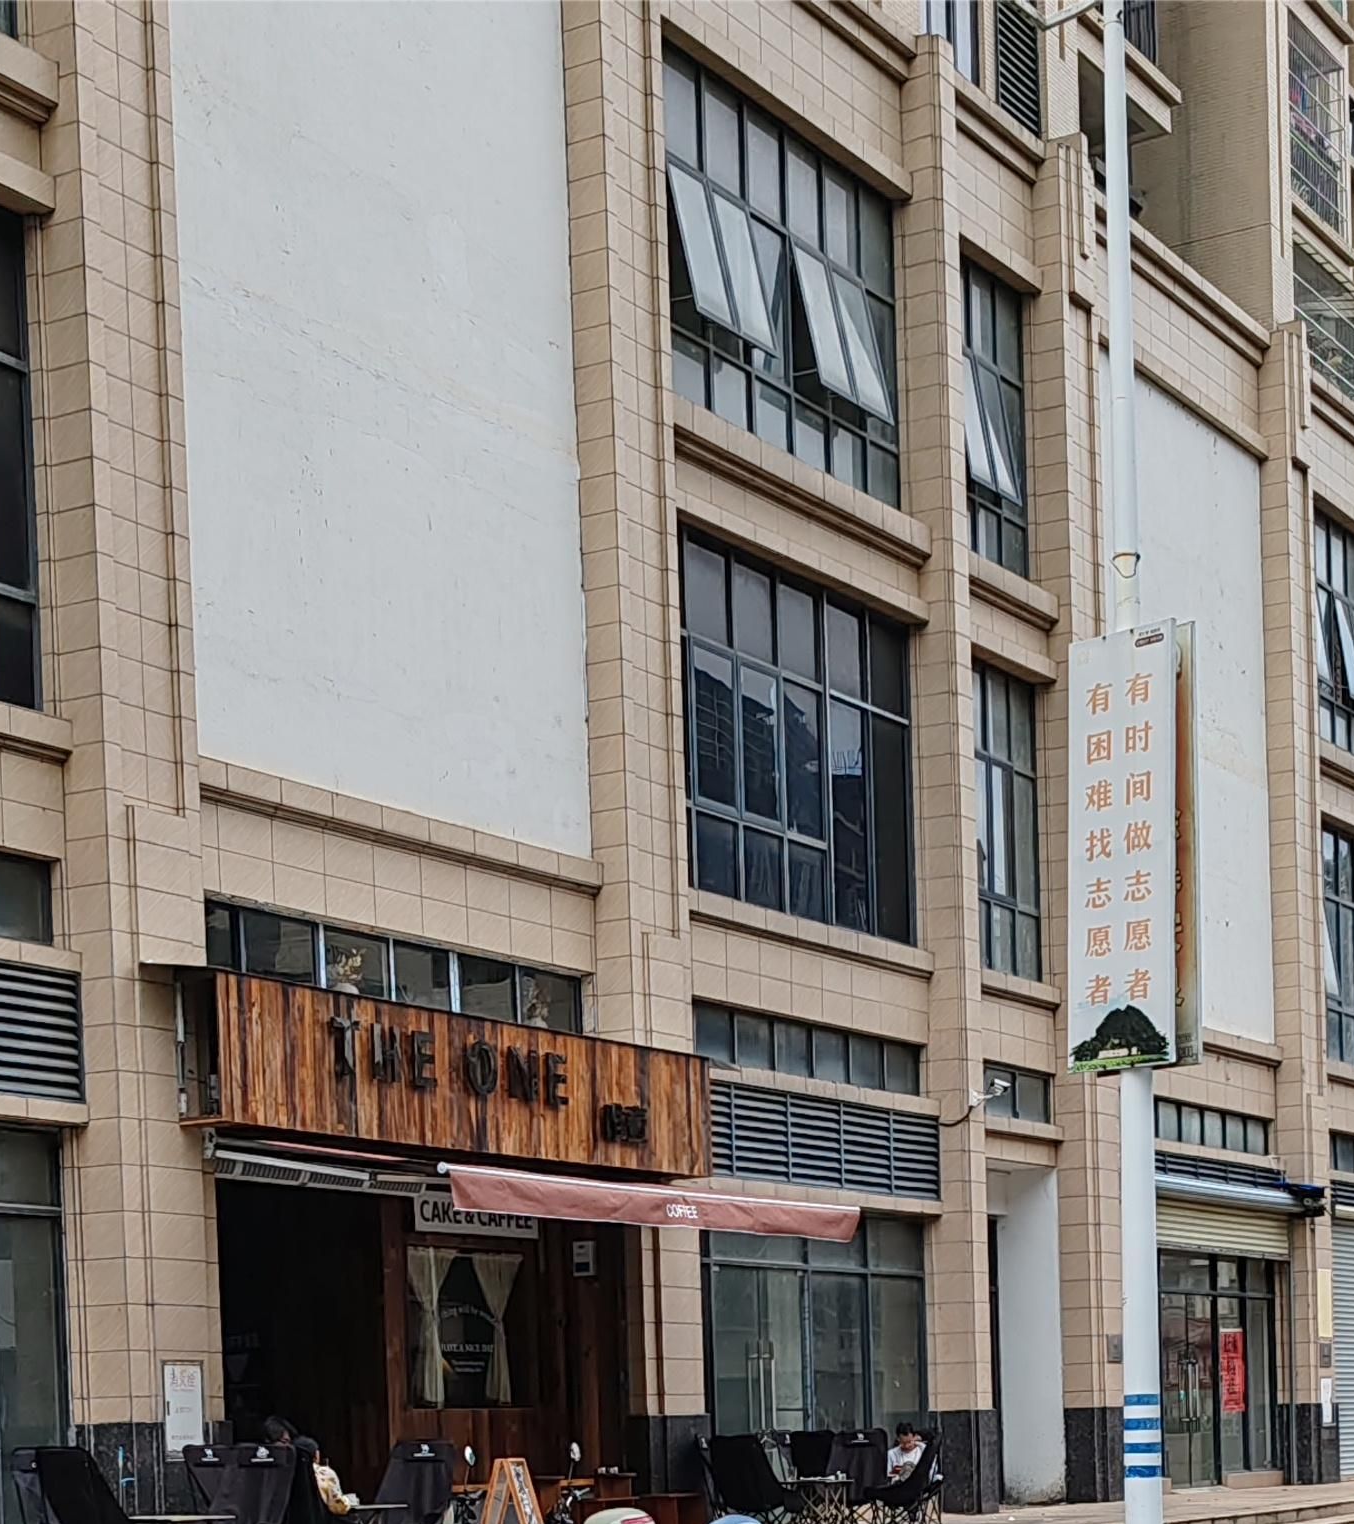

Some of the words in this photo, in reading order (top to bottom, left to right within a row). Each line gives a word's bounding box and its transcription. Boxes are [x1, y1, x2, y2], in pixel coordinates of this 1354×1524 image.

[1084, 682, 1113, 1008] 有困难找志愿者
[1124, 672, 1153, 1002] 有时间做志愿者
[329, 1015, 438, 1090] THE
[466, 1040, 570, 1110] ONE
[420, 1200, 463, 1225] CAKE
